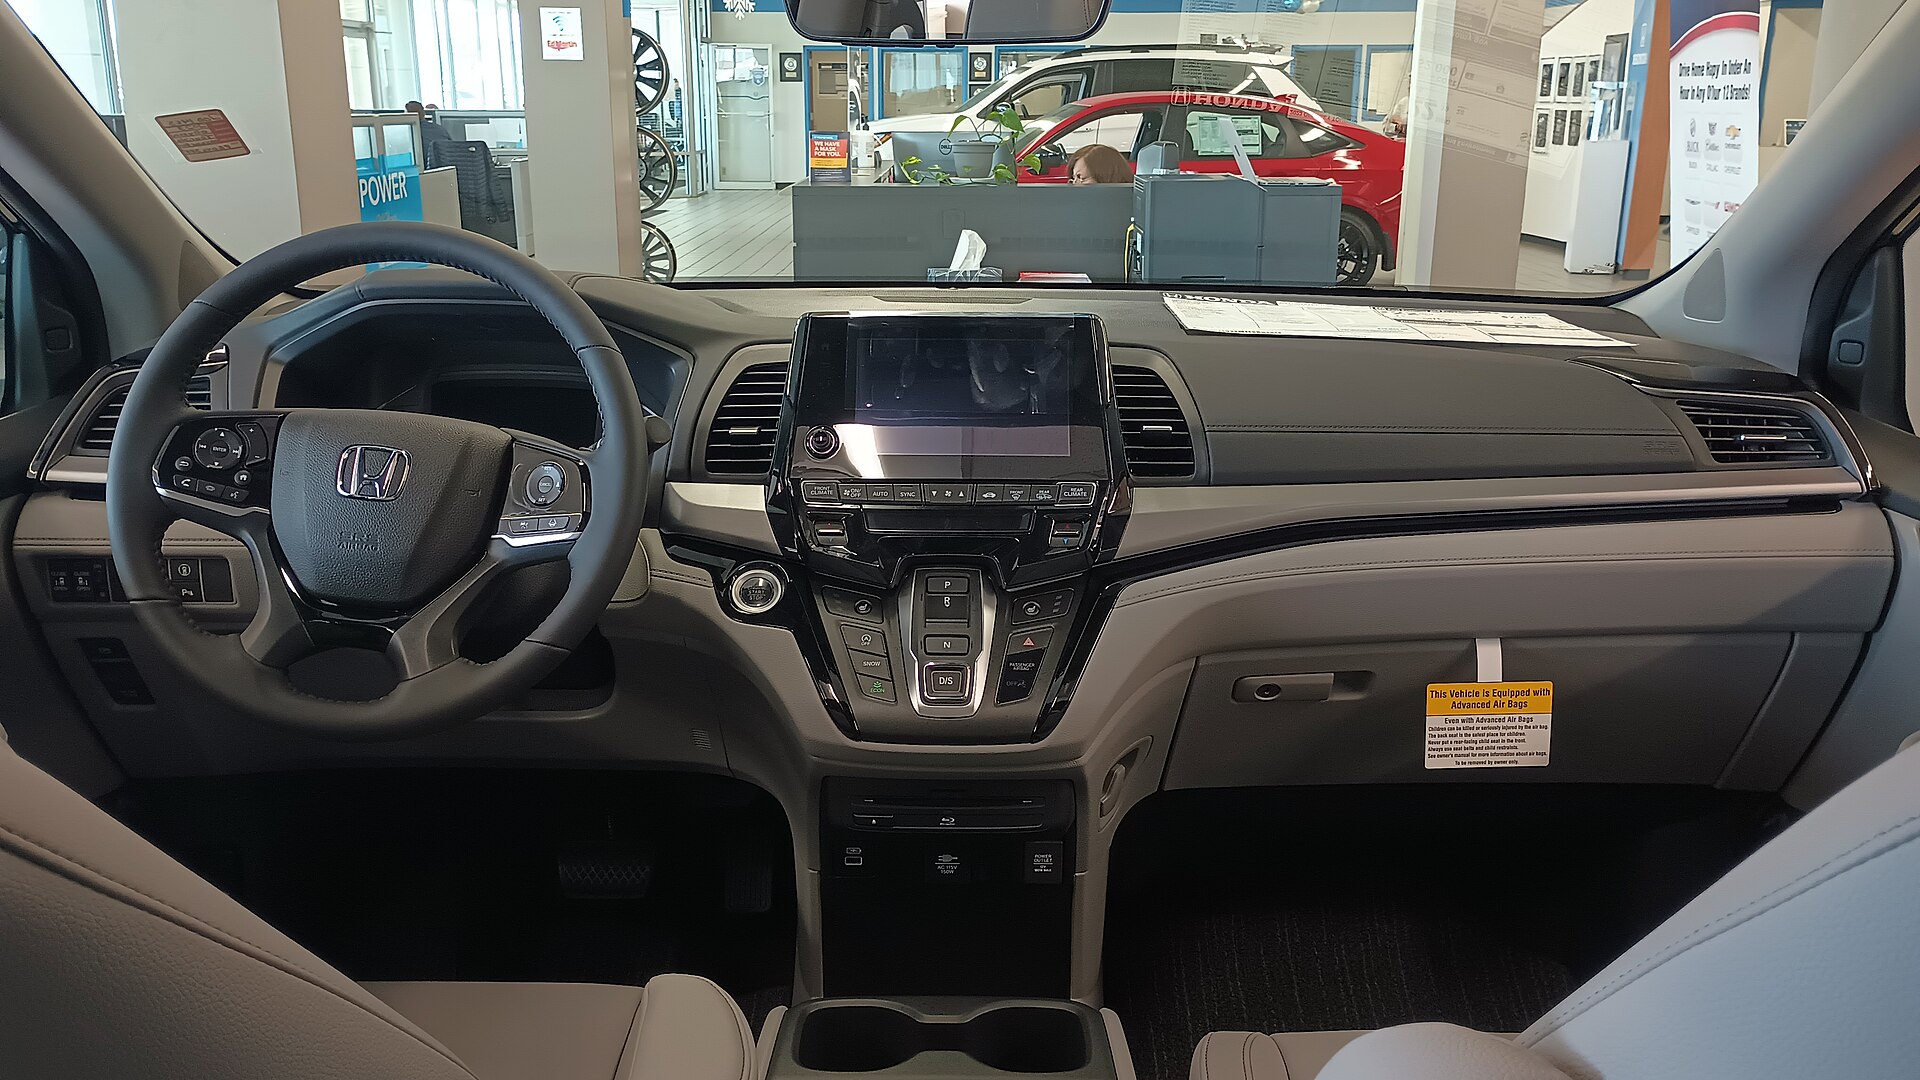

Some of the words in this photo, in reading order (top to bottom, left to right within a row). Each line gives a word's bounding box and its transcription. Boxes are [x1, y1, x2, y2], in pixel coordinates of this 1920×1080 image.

[1691, 62, 1705, 77] Home
[1721, 60, 1728, 75] In
[1728, 59, 1743, 75] Under
[1743, 58, 1751, 74] An
[1680, 85, 1690, 100] Hour
[1696, 85, 1706, 103] Any
[1722, 84, 1730, 100] 12
[359, 171, 408, 209] POWER
[944, 581, 951, 589] P
[944, 596, 951, 604] R
[938, 676, 953, 685] D/S
[1430, 689, 1447, 699] This
[1449, 689, 1480, 698] Vehicle
[1482, 688, 1490, 698] is
[1492, 688, 1531, 699] Equipped
[1532, 687, 1551, 697] with
[1450, 700, 1491, 710] Advanced
[1493, 700, 1505, 709] Air
[1507, 699, 1528, 710] Bags
[1475, 716, 1506, 724] Advanced
[1517, 715, 1534, 724] Bags
